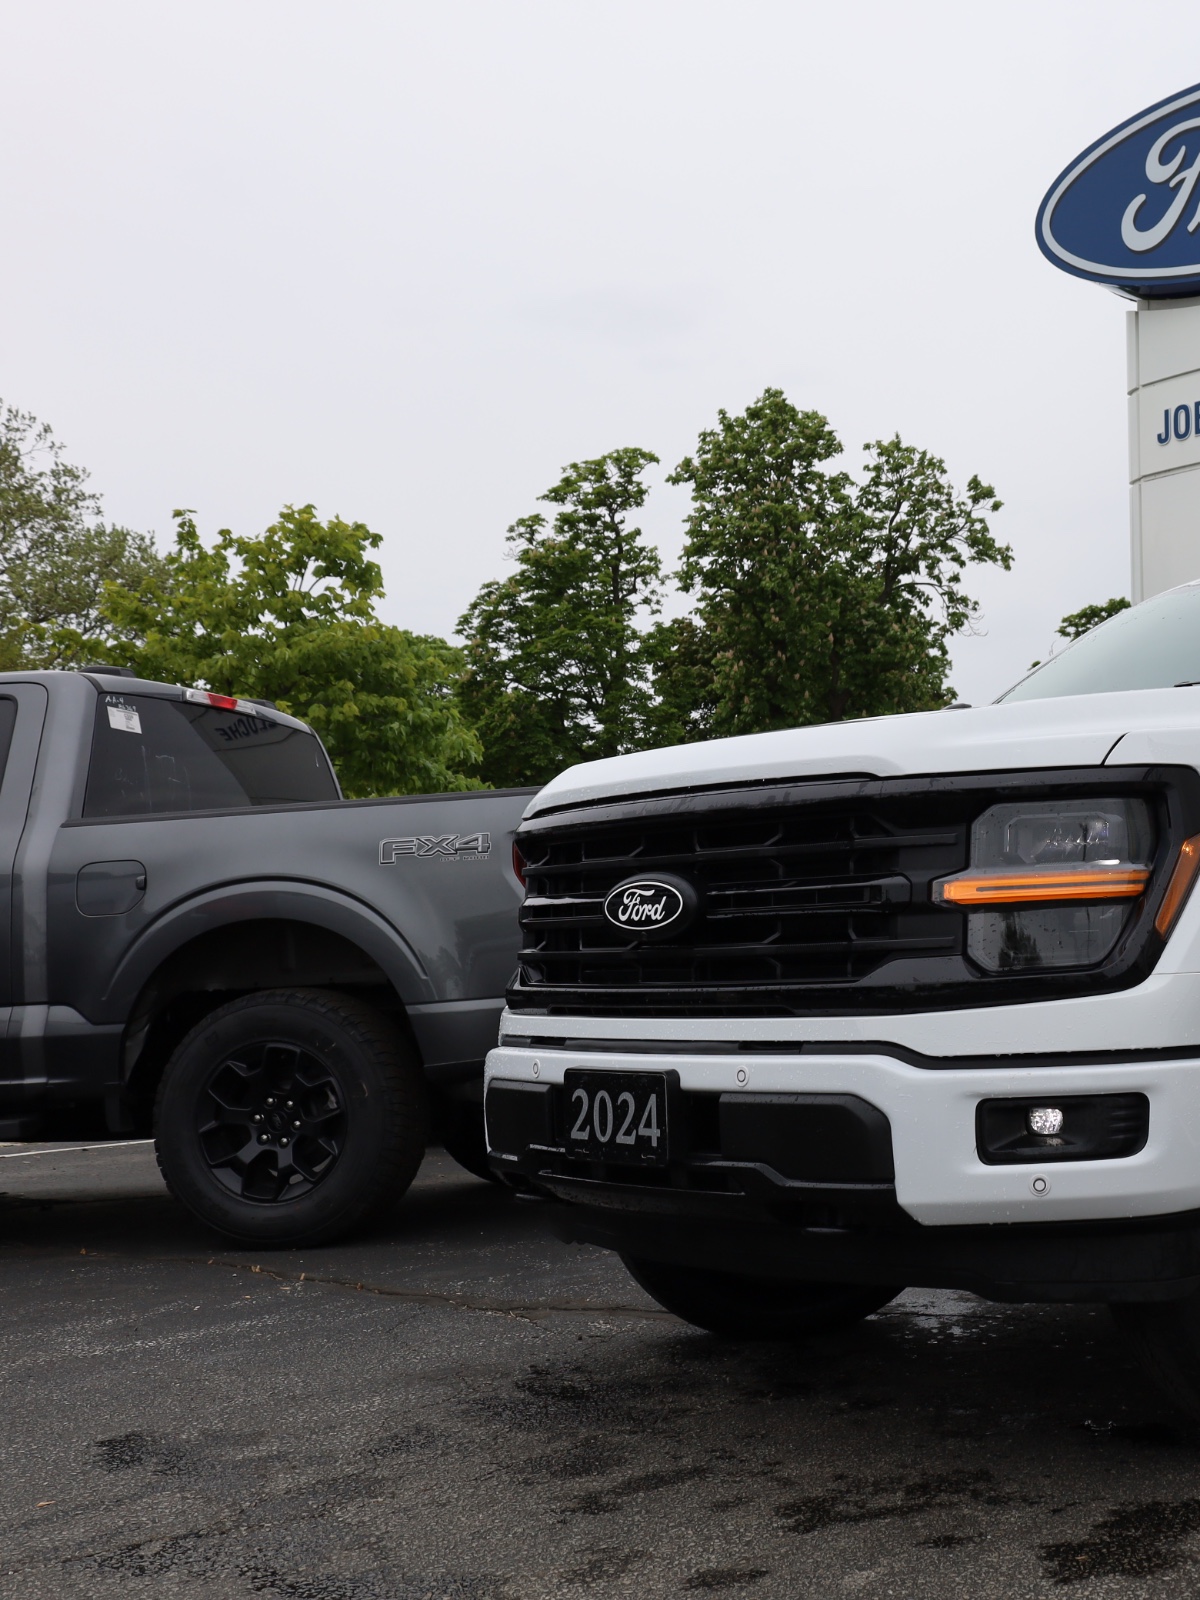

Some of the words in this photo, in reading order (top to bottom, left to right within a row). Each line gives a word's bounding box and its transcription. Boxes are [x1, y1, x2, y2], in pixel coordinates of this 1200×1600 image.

[379, 832, 491, 865] FX4
[618, 889, 666, 921] Ford
[571, 1088, 661, 1147] 2024
